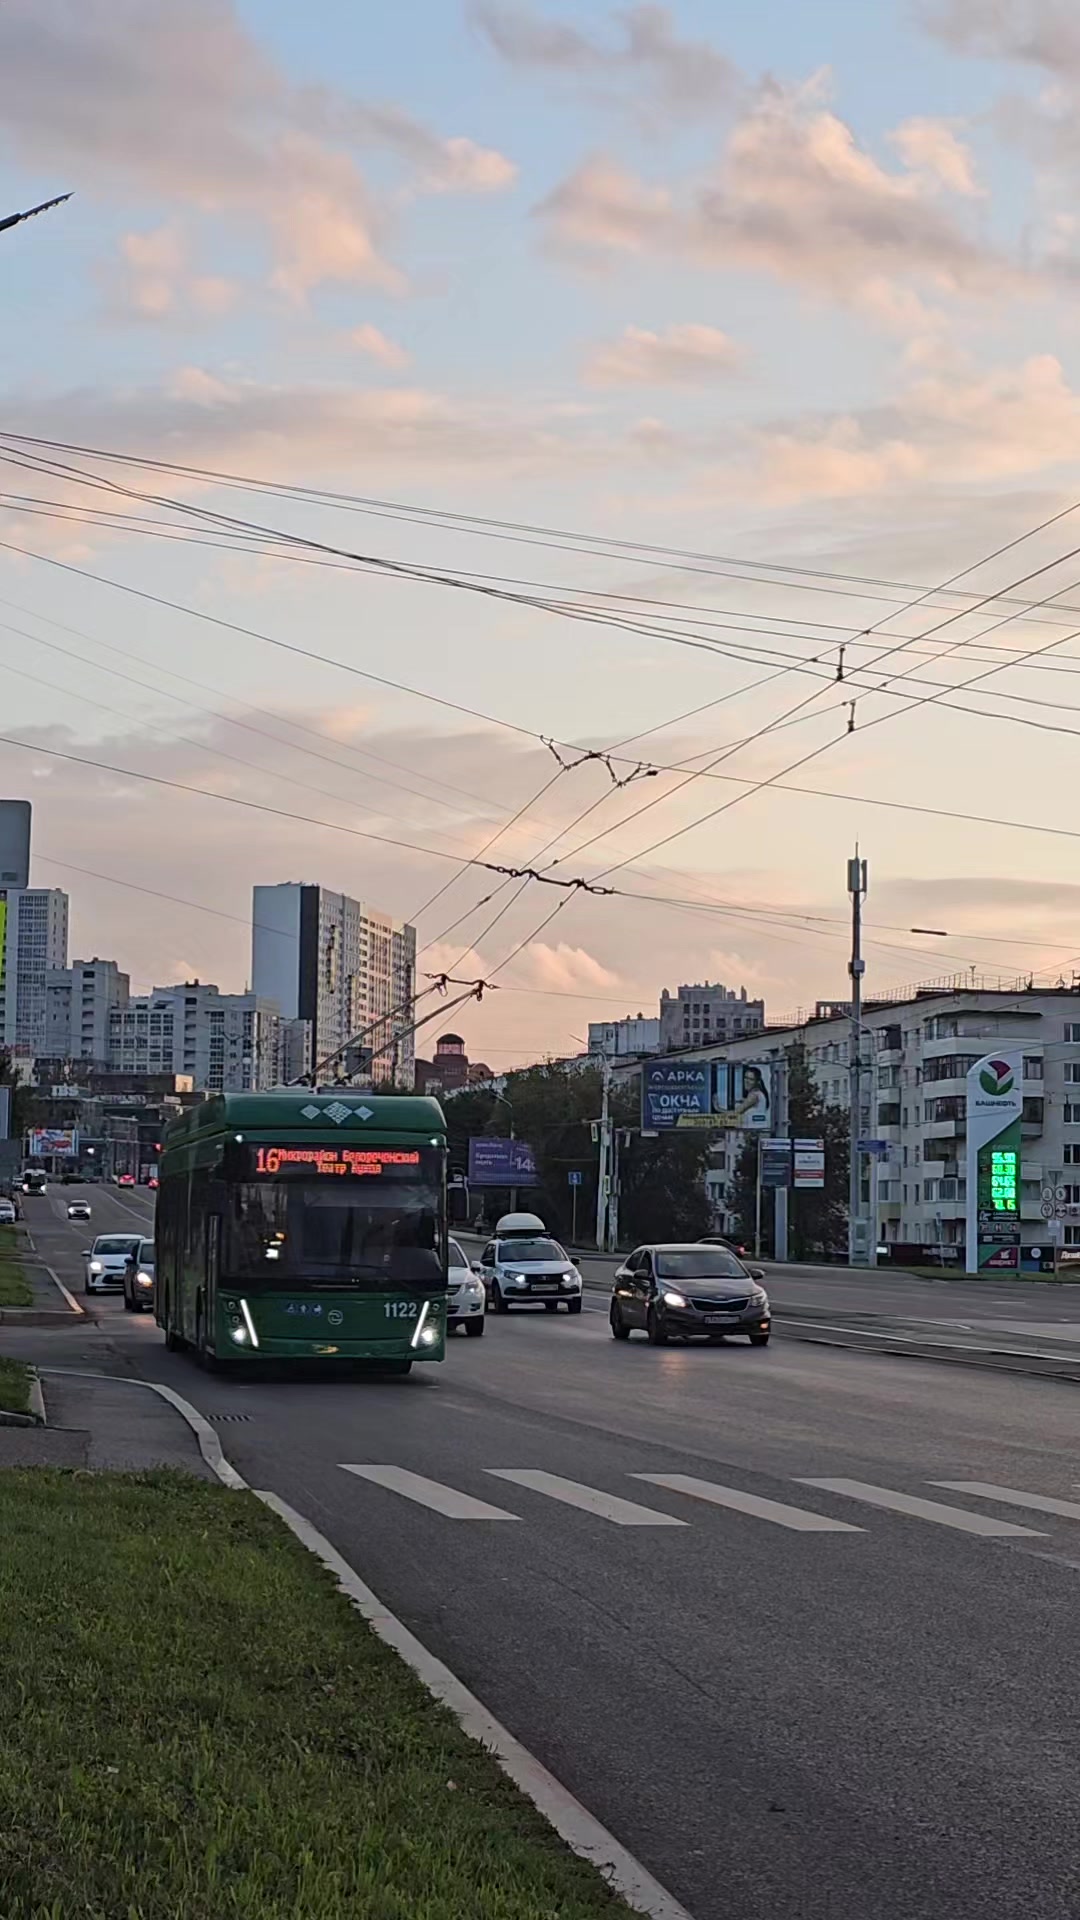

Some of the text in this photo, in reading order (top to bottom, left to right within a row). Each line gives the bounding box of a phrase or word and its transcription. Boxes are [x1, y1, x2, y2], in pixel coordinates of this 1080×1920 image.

[667, 1071, 705, 1081] АРКА
[660, 1094, 701, 1107] ОКНА
[256, 1148, 280, 1173] 16
[384, 1303, 417, 1318] 1122
